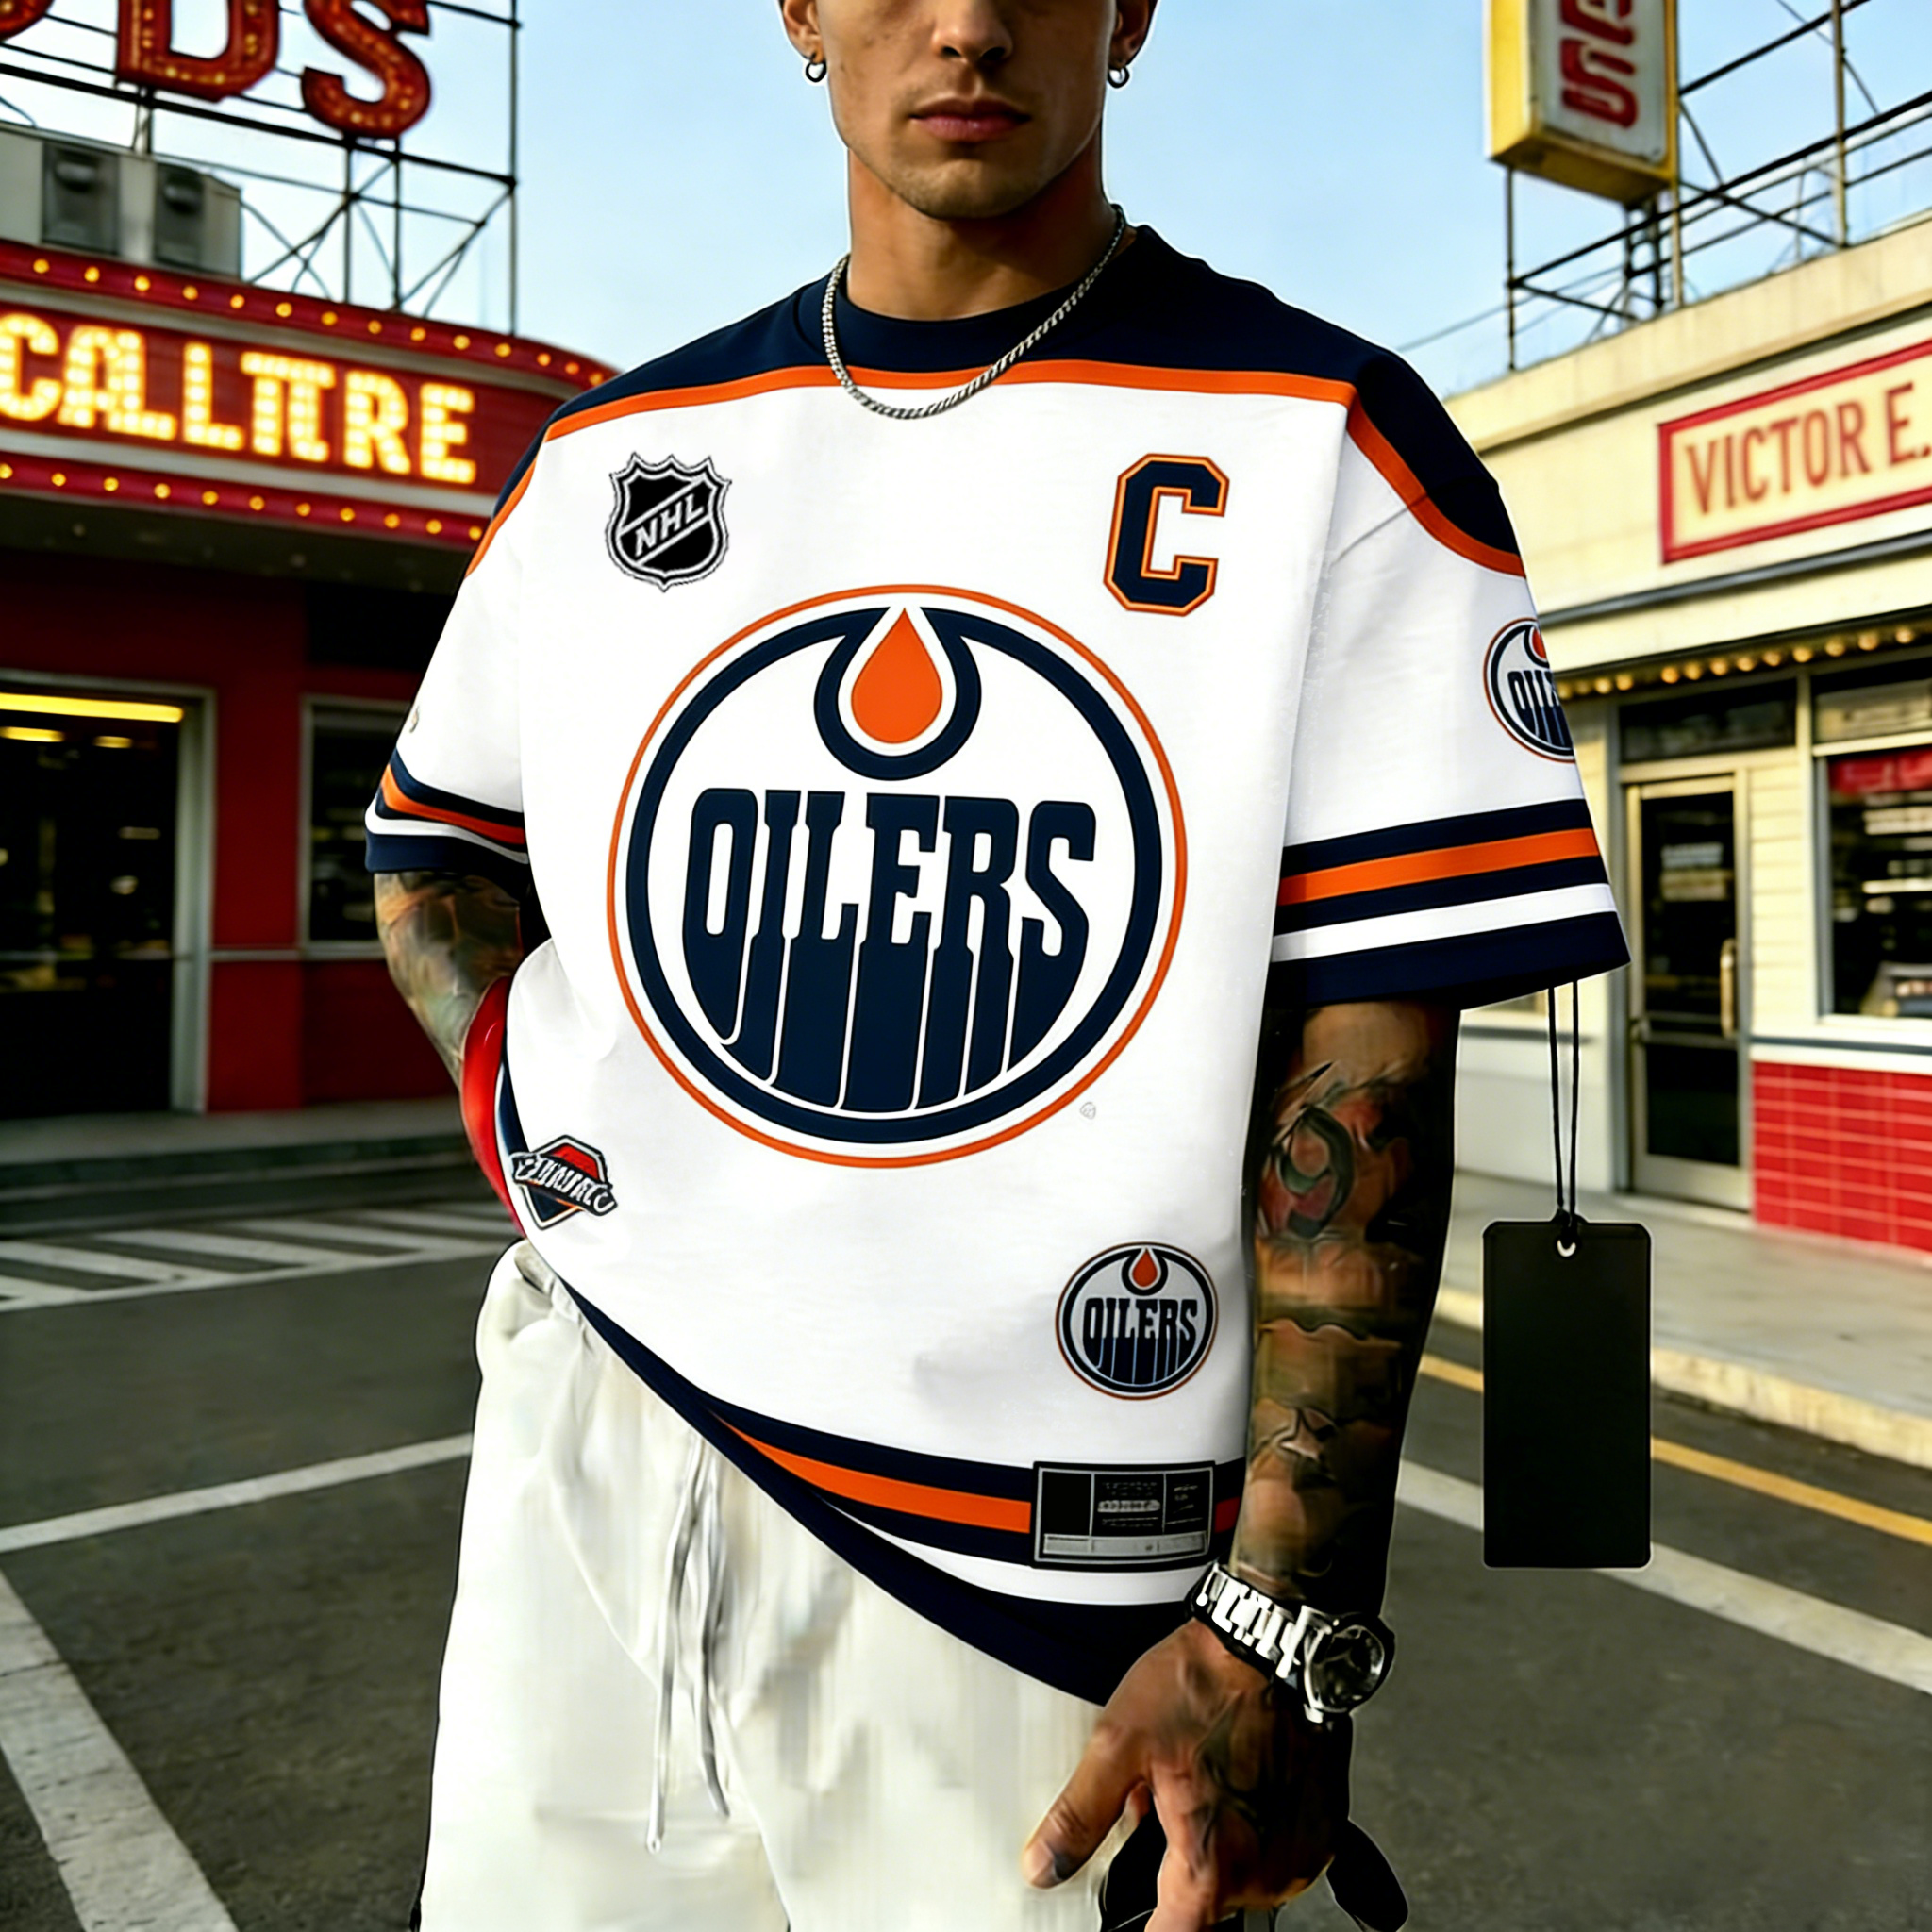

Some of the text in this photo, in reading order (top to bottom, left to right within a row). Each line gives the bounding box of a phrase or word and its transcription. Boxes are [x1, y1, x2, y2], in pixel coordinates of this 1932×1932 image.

[1685, 400, 1872, 515] VICTOR
[635, 493, 704, 558] NHL
[1103, 453, 1229, 617] C
[681, 787, 1097, 1111] OILERS
[1082, 1296, 1198, 1384] OILERS
